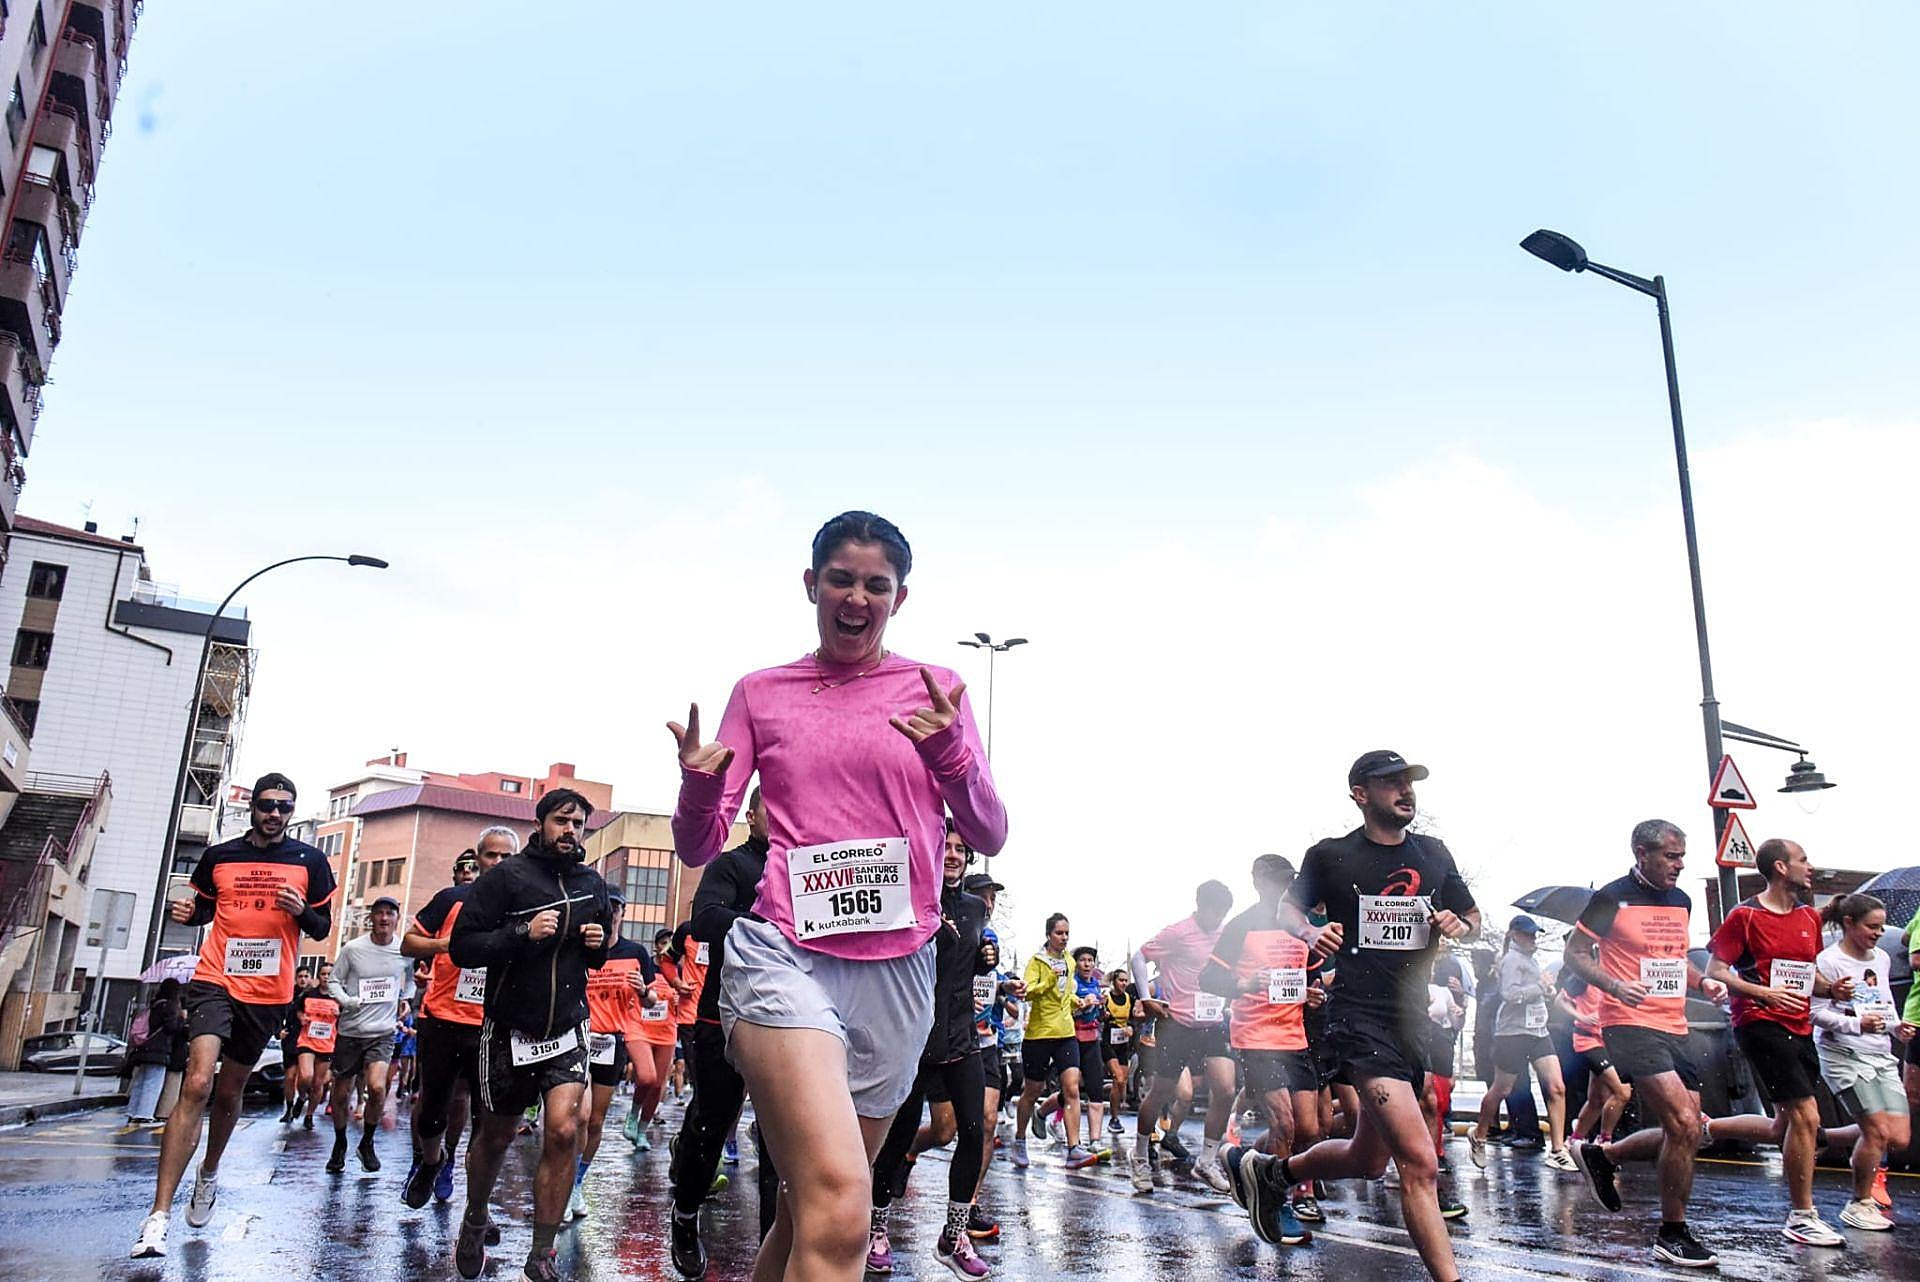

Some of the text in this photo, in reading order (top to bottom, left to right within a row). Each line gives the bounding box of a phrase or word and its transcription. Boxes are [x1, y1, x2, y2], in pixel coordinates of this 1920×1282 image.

[813, 853, 829, 863] EL
[831, 847, 883, 861] CORREO
[802, 865, 898, 893] XXXVII SANTURCE
[856, 873, 899, 884] BILBAO
[828, 889, 882, 917] 1565
[818, 915, 871, 931] kutxabank
[1366, 911, 1397, 922] XXXVII
[1382, 925, 1412, 940] 2107
[242, 958, 262, 970] 896
[1657, 979, 1678, 990] 2464
[370, 990, 385, 998] 2512
[1282, 987, 1298, 997] 3101
[531, 1041, 560, 1056] 3150
